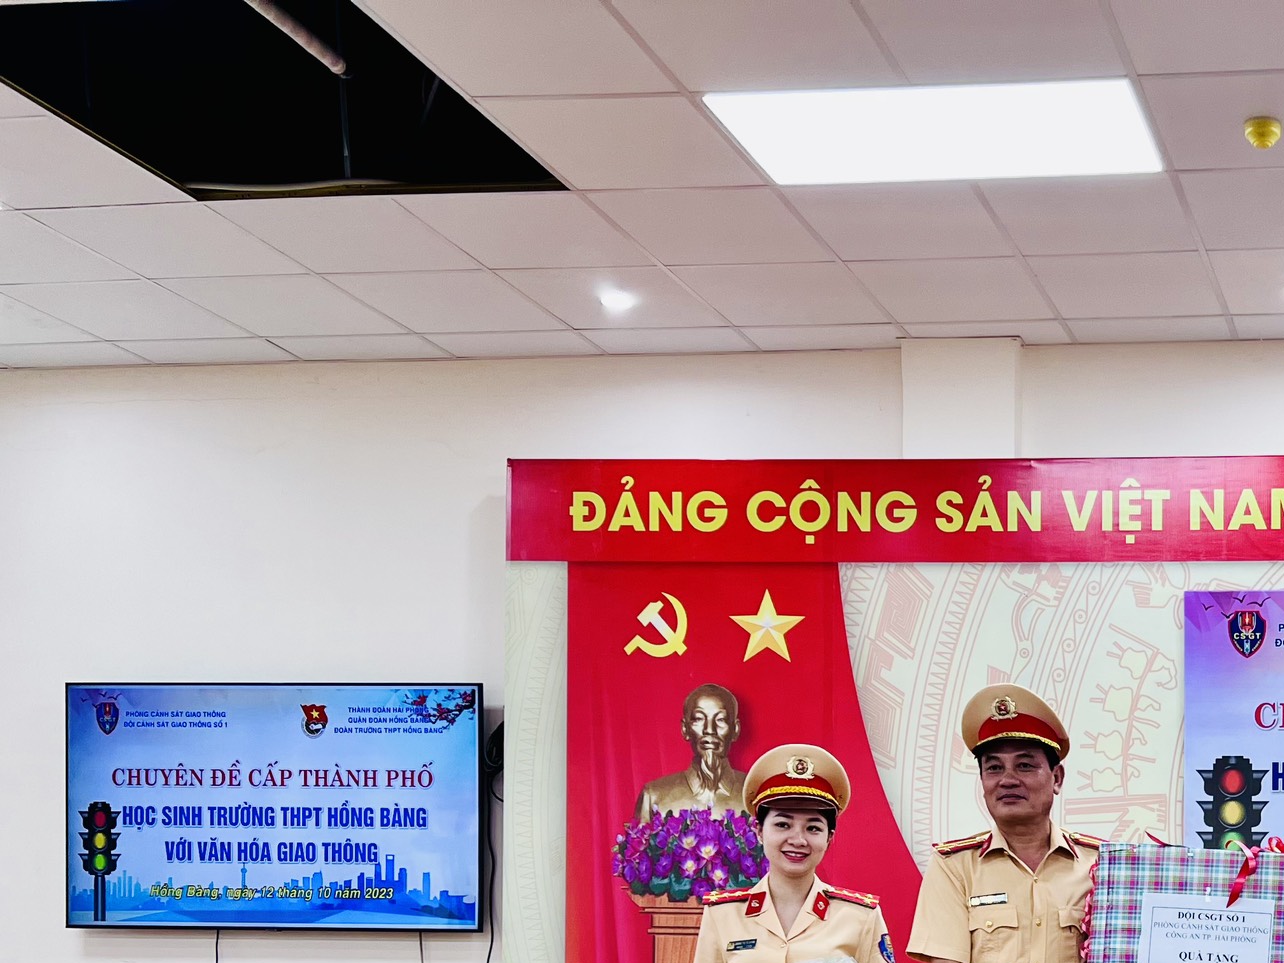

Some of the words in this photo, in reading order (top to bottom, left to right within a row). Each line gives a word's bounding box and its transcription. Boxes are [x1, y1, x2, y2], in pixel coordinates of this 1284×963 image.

[570, 475, 728, 533] ĐẢNG
[746, 478, 917, 544] CỘNG
[935, 474, 1043, 532] SẢN
[1062, 477, 1170, 544] VIỆT
[1233, 632, 1261, 640] CSGT
[112, 762, 203, 788] CHUYÊN
[210, 759, 241, 788] ĐỀ
[248, 760, 292, 788] CẤP
[298, 761, 377, 788] THÀNH
[386, 760, 434, 788] PHỐ
[122, 805, 156, 831] HỌC
[161, 806, 201, 828] SINH
[207, 801, 275, 828] TRƯỜNG
[280, 806, 322, 828] THPT
[327, 801, 375, 828] HỒNG
[380, 803, 427, 828] BÀNG
[165, 838, 191, 863] VỚI
[198, 839, 232, 863] VĂN
[238, 837, 272, 863] HÓA
[277, 841, 317, 863] GIAO
[322, 838, 378, 863] THÔNG
[226, 885, 255, 900] ngày
[260, 887, 275, 898] 12
[277, 886, 313, 901] tháng
[318, 887, 331, 899] 10
[335, 887, 361, 898] năm
[364, 887, 394, 899] 2023
[1198, 912, 1223, 921] CSGT
